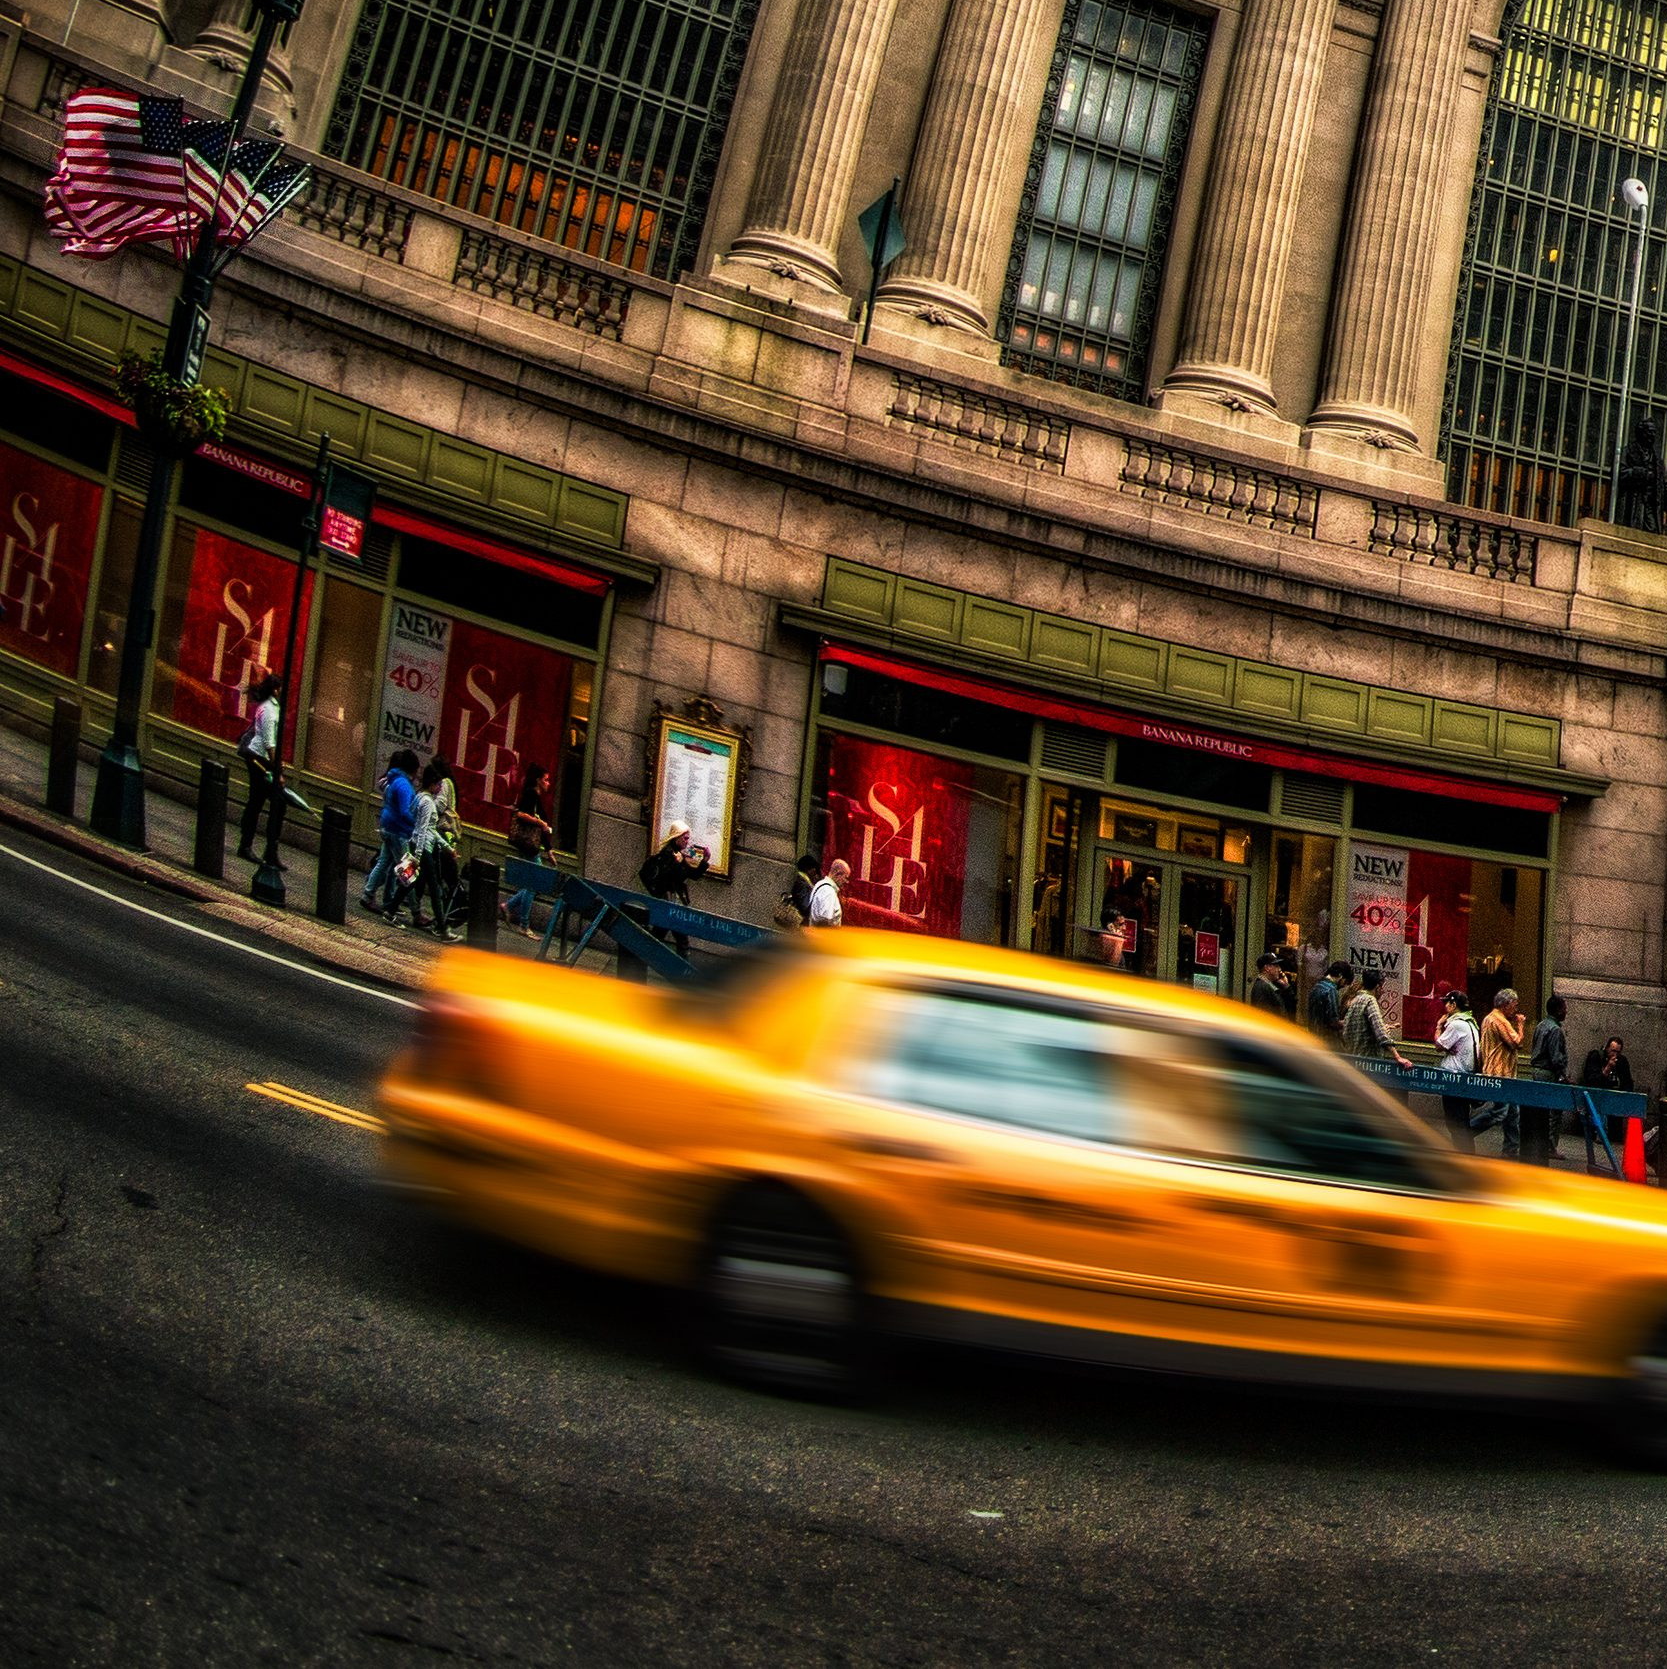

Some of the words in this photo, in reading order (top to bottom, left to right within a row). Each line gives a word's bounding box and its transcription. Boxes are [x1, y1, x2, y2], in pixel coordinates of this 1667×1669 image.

[202, 442, 249, 473] BANANA
[248, 462, 305, 494] REPUBLIC
[398, 607, 448, 640] NEW
[389, 665, 440, 699] 40%
[384, 711, 435, 744] NEW
[1142, 724, 1194, 746] BANANA
[1194, 734, 1254, 758] REPUBLIC
[856, 780, 928, 920] SALE
[1354, 853, 1403, 878] NEW
[668, 908, 706, 926] POLICE
[1350, 904, 1402, 930] 40%
[1349, 946, 1400, 971] NEW
[1355, 1060, 1392, 1074] POLICE
[1396, 1067, 1418, 1079] LINE
[1423, 1070, 1438, 1081] DO
[1441, 1072, 1462, 1083] NOT
[1466, 1076, 1503, 1089] CROSS
